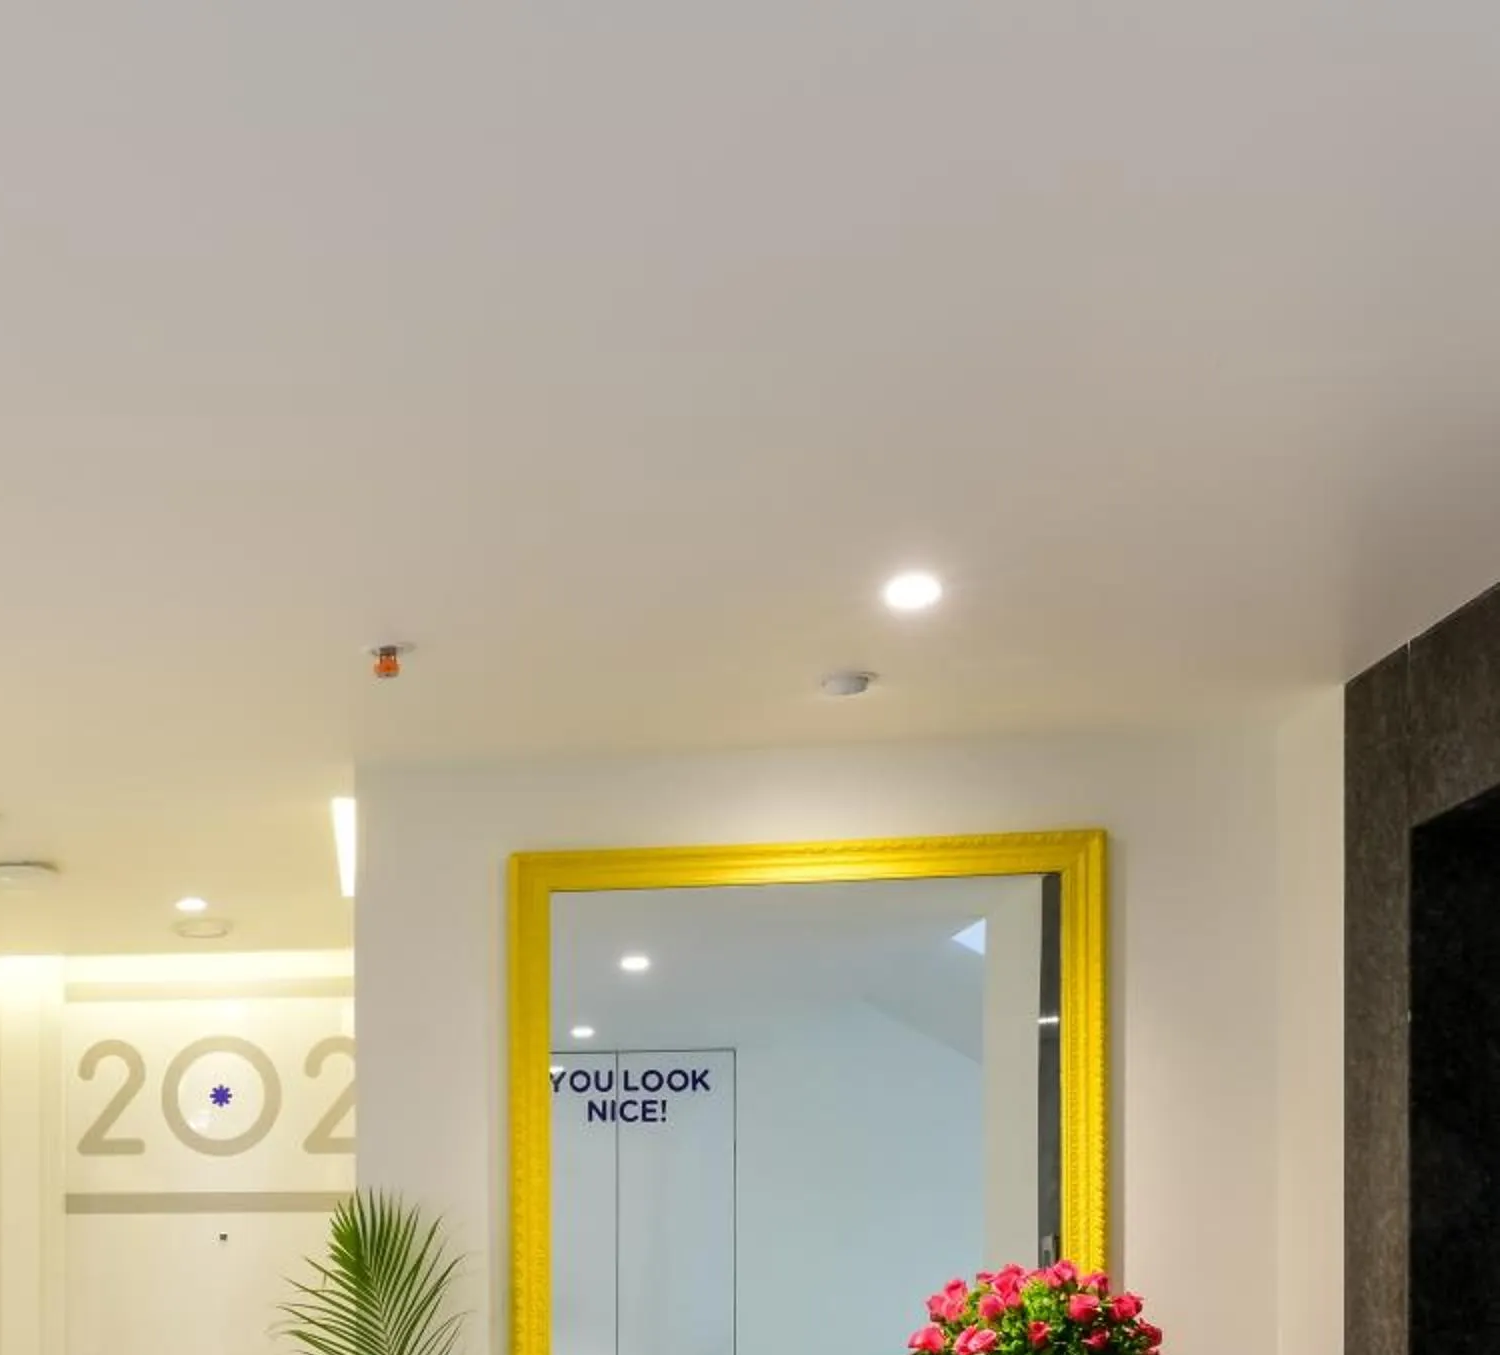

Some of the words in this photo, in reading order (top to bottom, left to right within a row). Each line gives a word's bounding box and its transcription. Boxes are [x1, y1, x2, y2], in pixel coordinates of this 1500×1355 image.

[550, 1069, 613, 1093] YOU
[623, 1069, 711, 1092] LOOK
[77, 1035, 356, 1156] 202
[587, 1099, 668, 1123] NICE!
